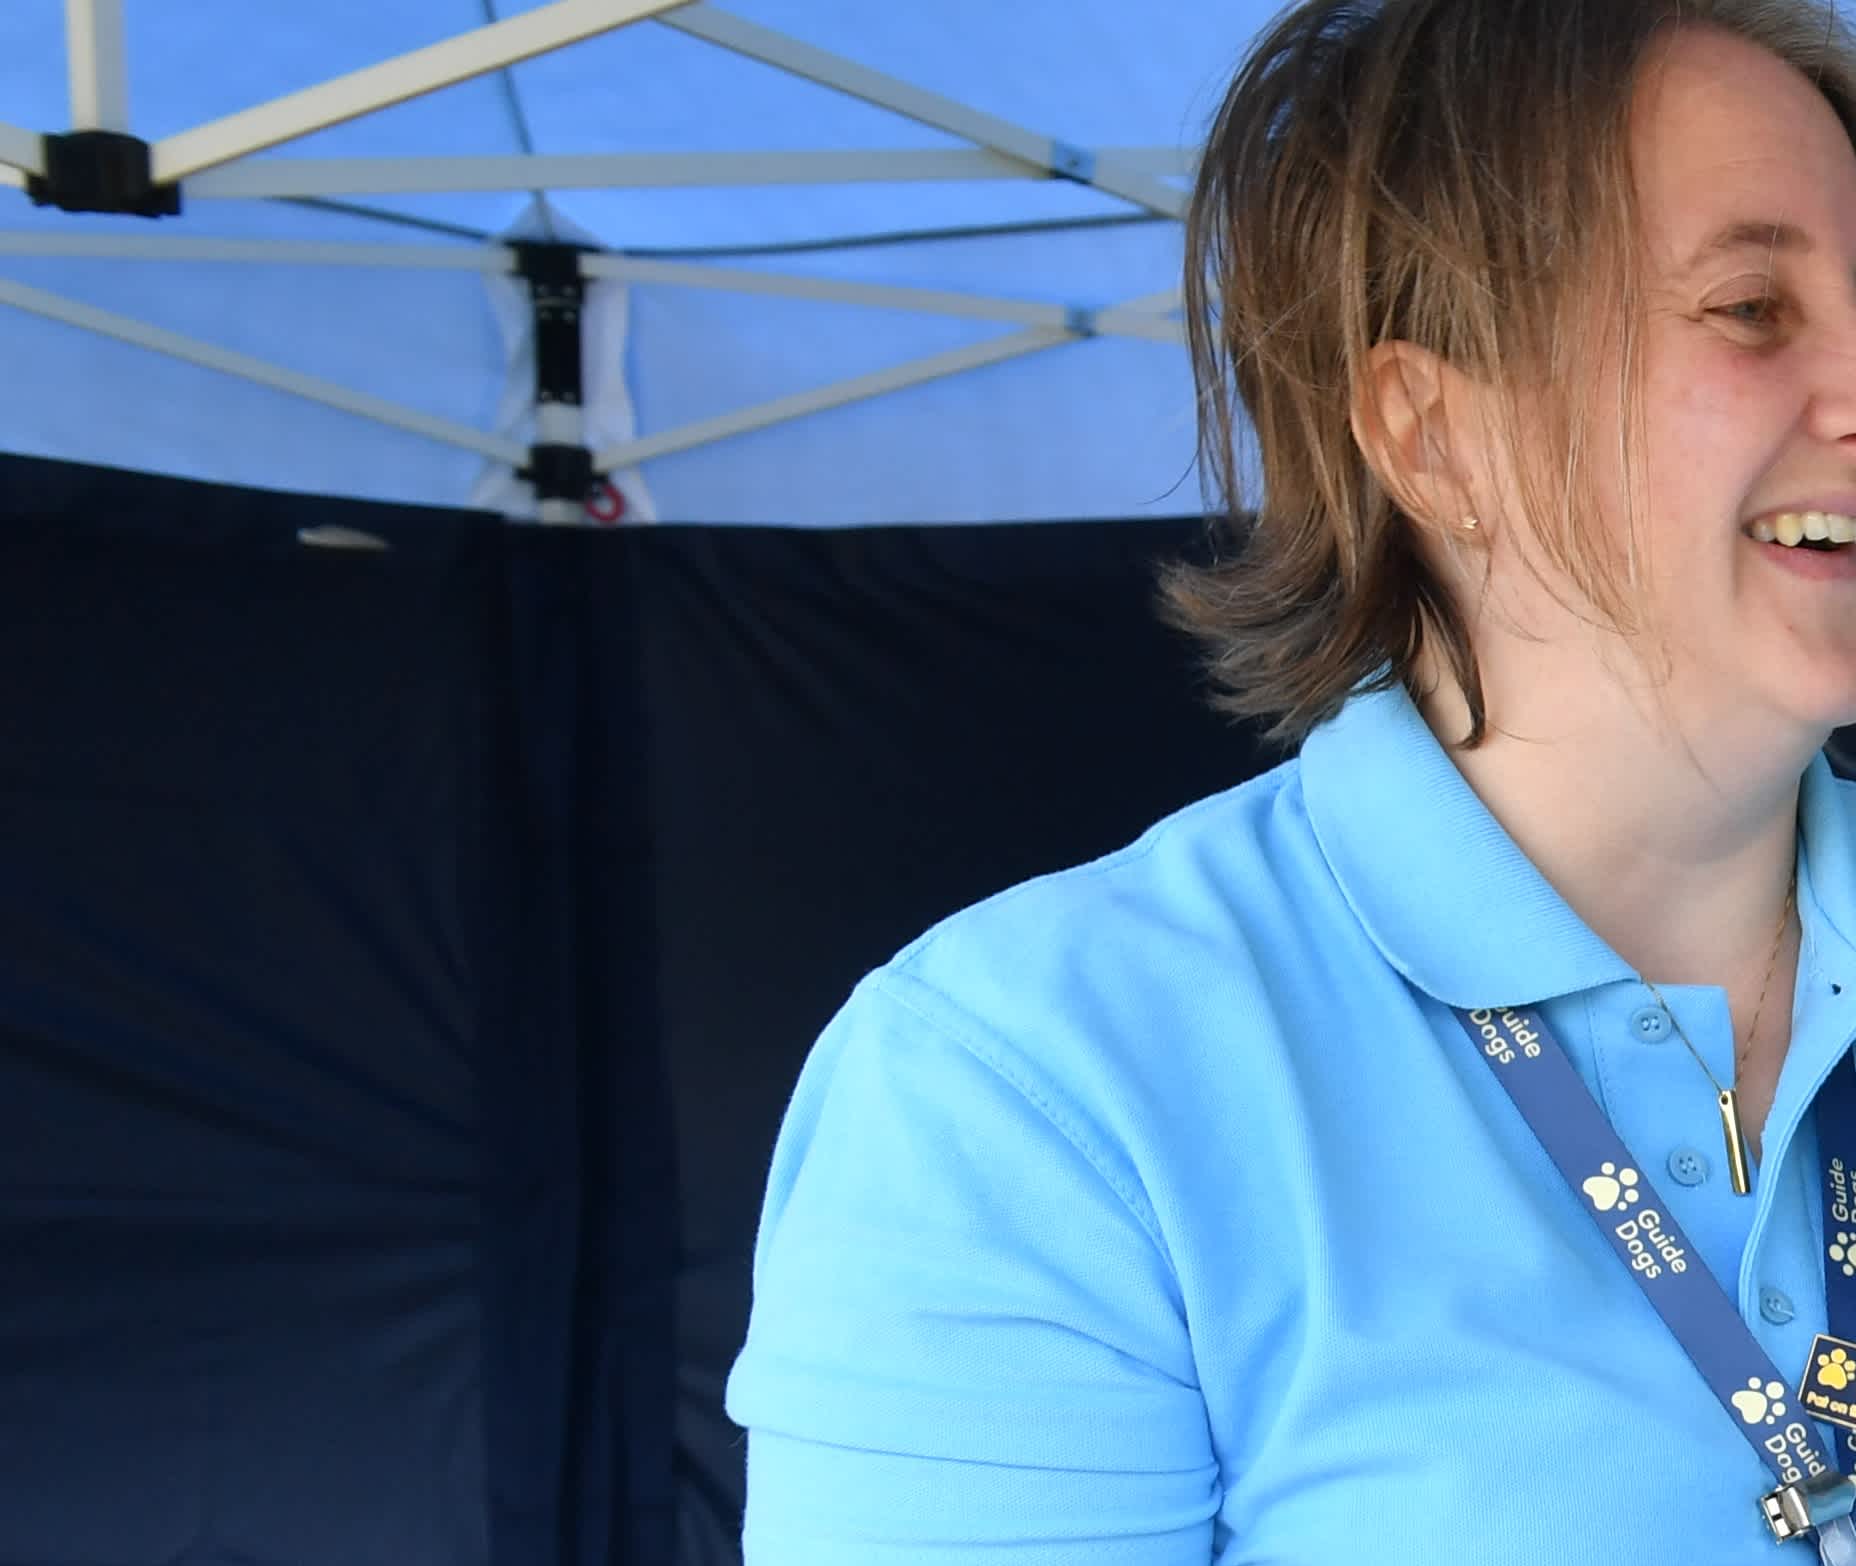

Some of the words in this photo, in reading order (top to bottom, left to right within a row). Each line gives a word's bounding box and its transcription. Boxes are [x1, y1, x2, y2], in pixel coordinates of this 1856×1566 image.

[1497, 1006, 1541, 1058] uide
[1829, 1157, 1849, 1223] Guide
[1615, 1220, 1662, 1279] Dogs
[1637, 1209, 1687, 1273] Guide
[1807, 1391, 1830, 1409] Pat
[1829, 1401, 1848, 1415] on
[1764, 1434, 1802, 1484] Dog
[1786, 1422, 1826, 1477] Guid
